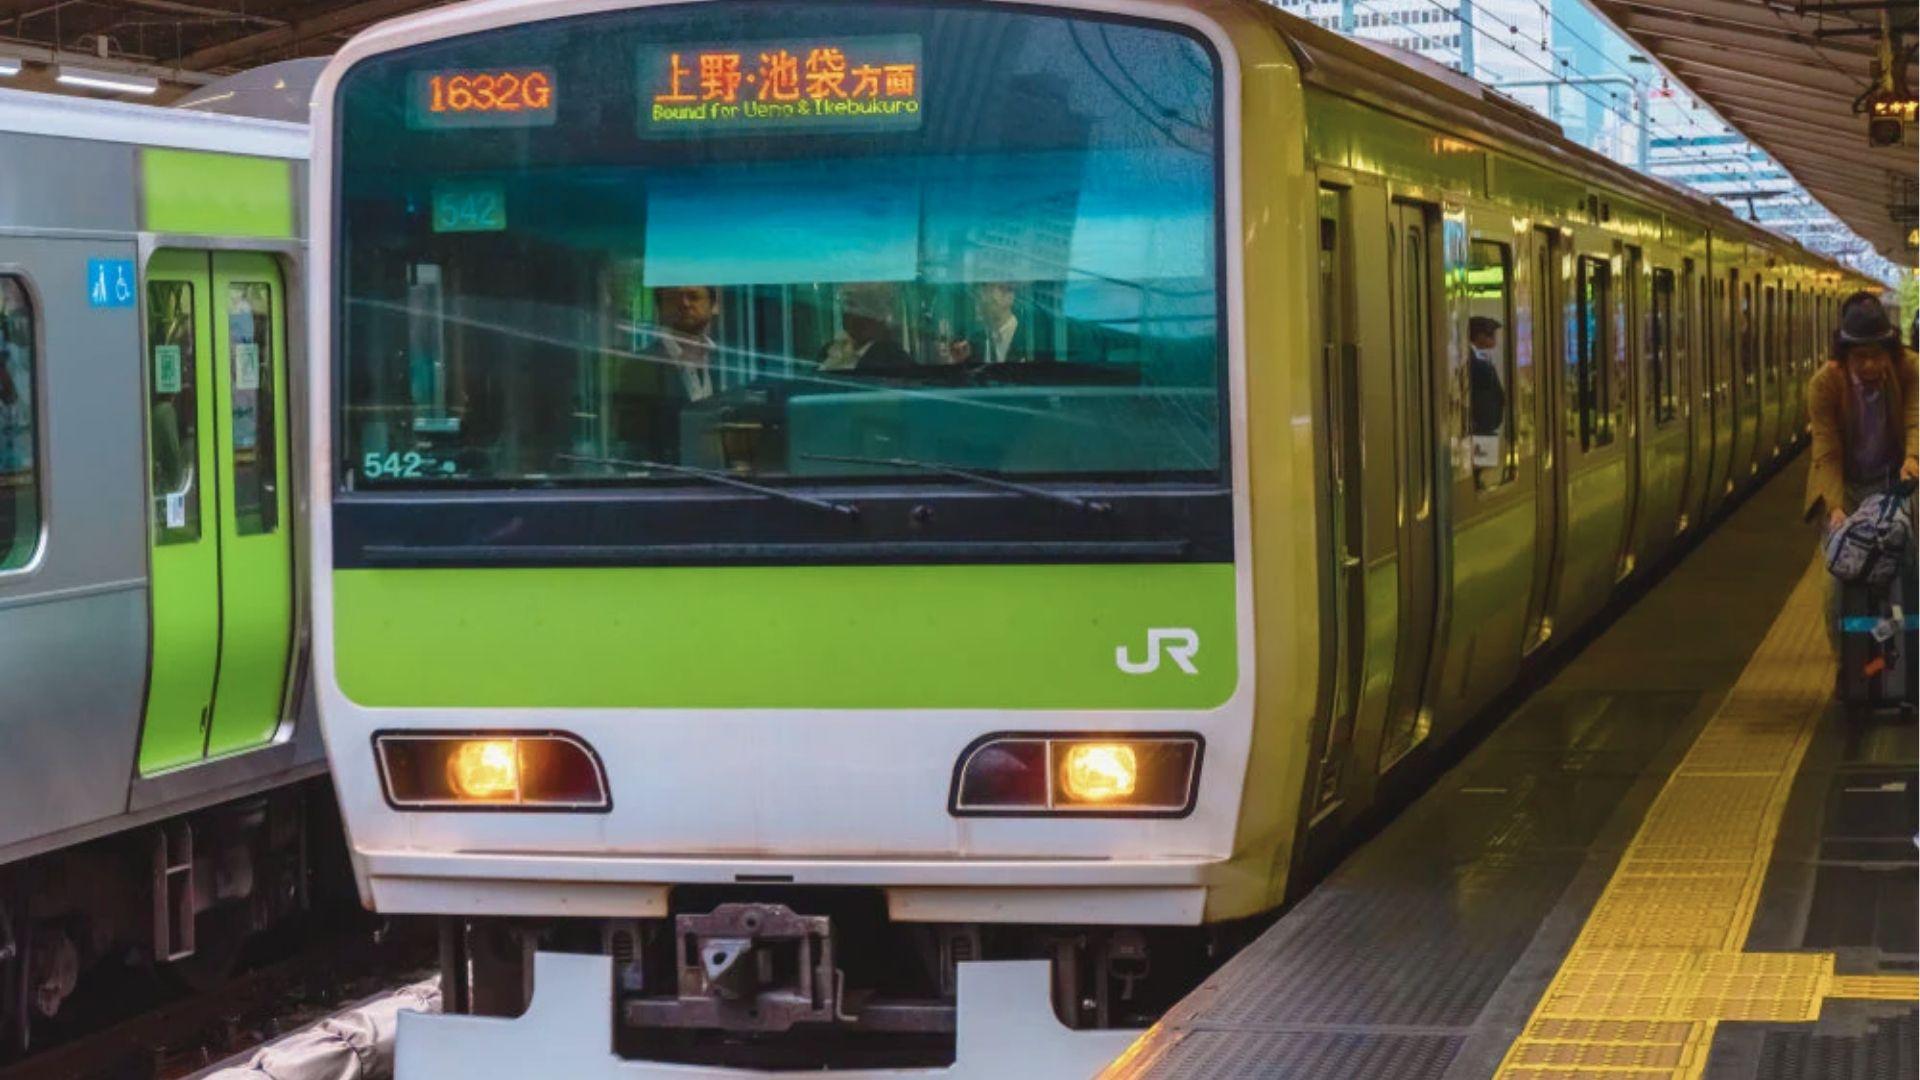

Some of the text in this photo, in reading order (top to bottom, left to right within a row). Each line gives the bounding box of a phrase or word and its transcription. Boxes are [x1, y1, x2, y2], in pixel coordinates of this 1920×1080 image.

[430, 71, 551, 113] 1632G
[652, 98, 919, 121] Bound for Ueno & Ikebukuro
[441, 193, 497, 227] 542
[364, 451, 423, 478] 542
[1116, 627, 1199, 674] JR
